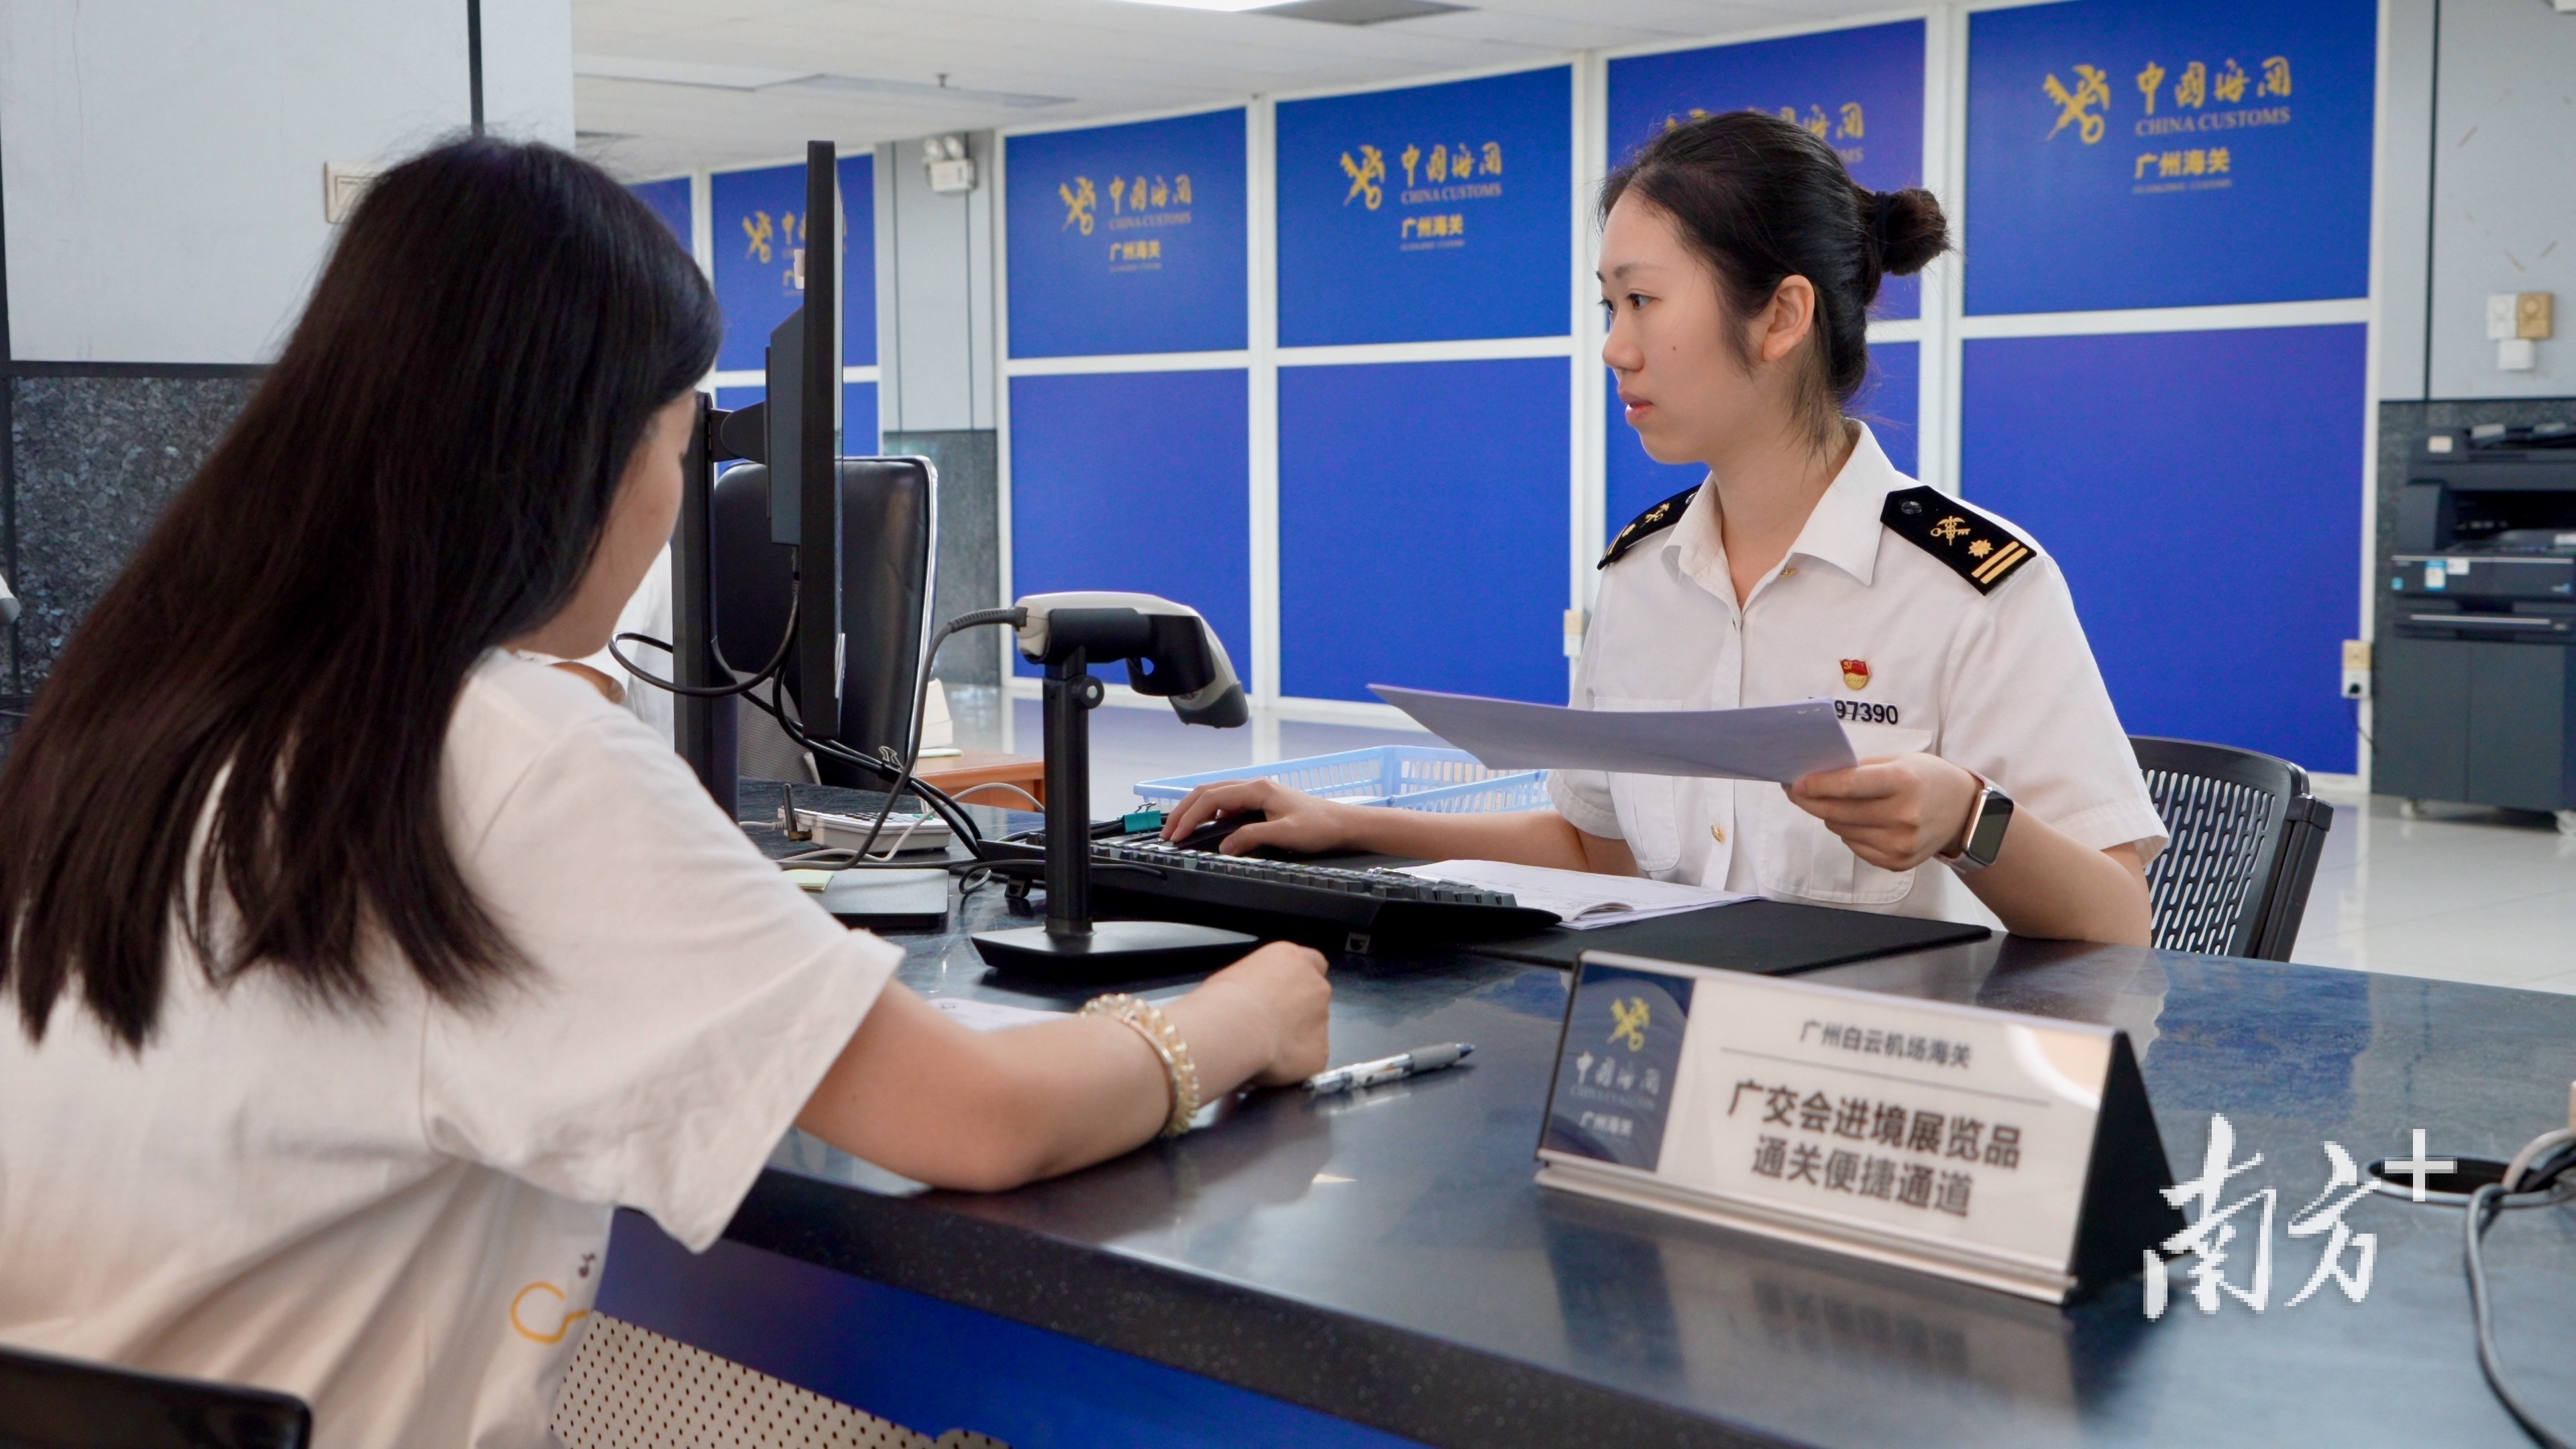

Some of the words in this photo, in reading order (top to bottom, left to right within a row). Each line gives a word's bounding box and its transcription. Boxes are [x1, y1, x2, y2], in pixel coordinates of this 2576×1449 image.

[2135, 115, 2196, 136] CHINA
[2199, 107, 2292, 131] CUSTOMS
[2134, 146, 2231, 179] 广州海关
[1401, 189, 1441, 205] CHINA
[1442, 182, 1503, 201] CUSTOMS
[1401, 213, 1464, 239] 广州海关
[1834, 699, 1899, 725] 97390
[1799, 1019, 1972, 1069] 广州白云机场海关
[1727, 1079, 2022, 1169] 广交会进境展览品
[1751, 1133, 1974, 1218] 通关便捷通道
